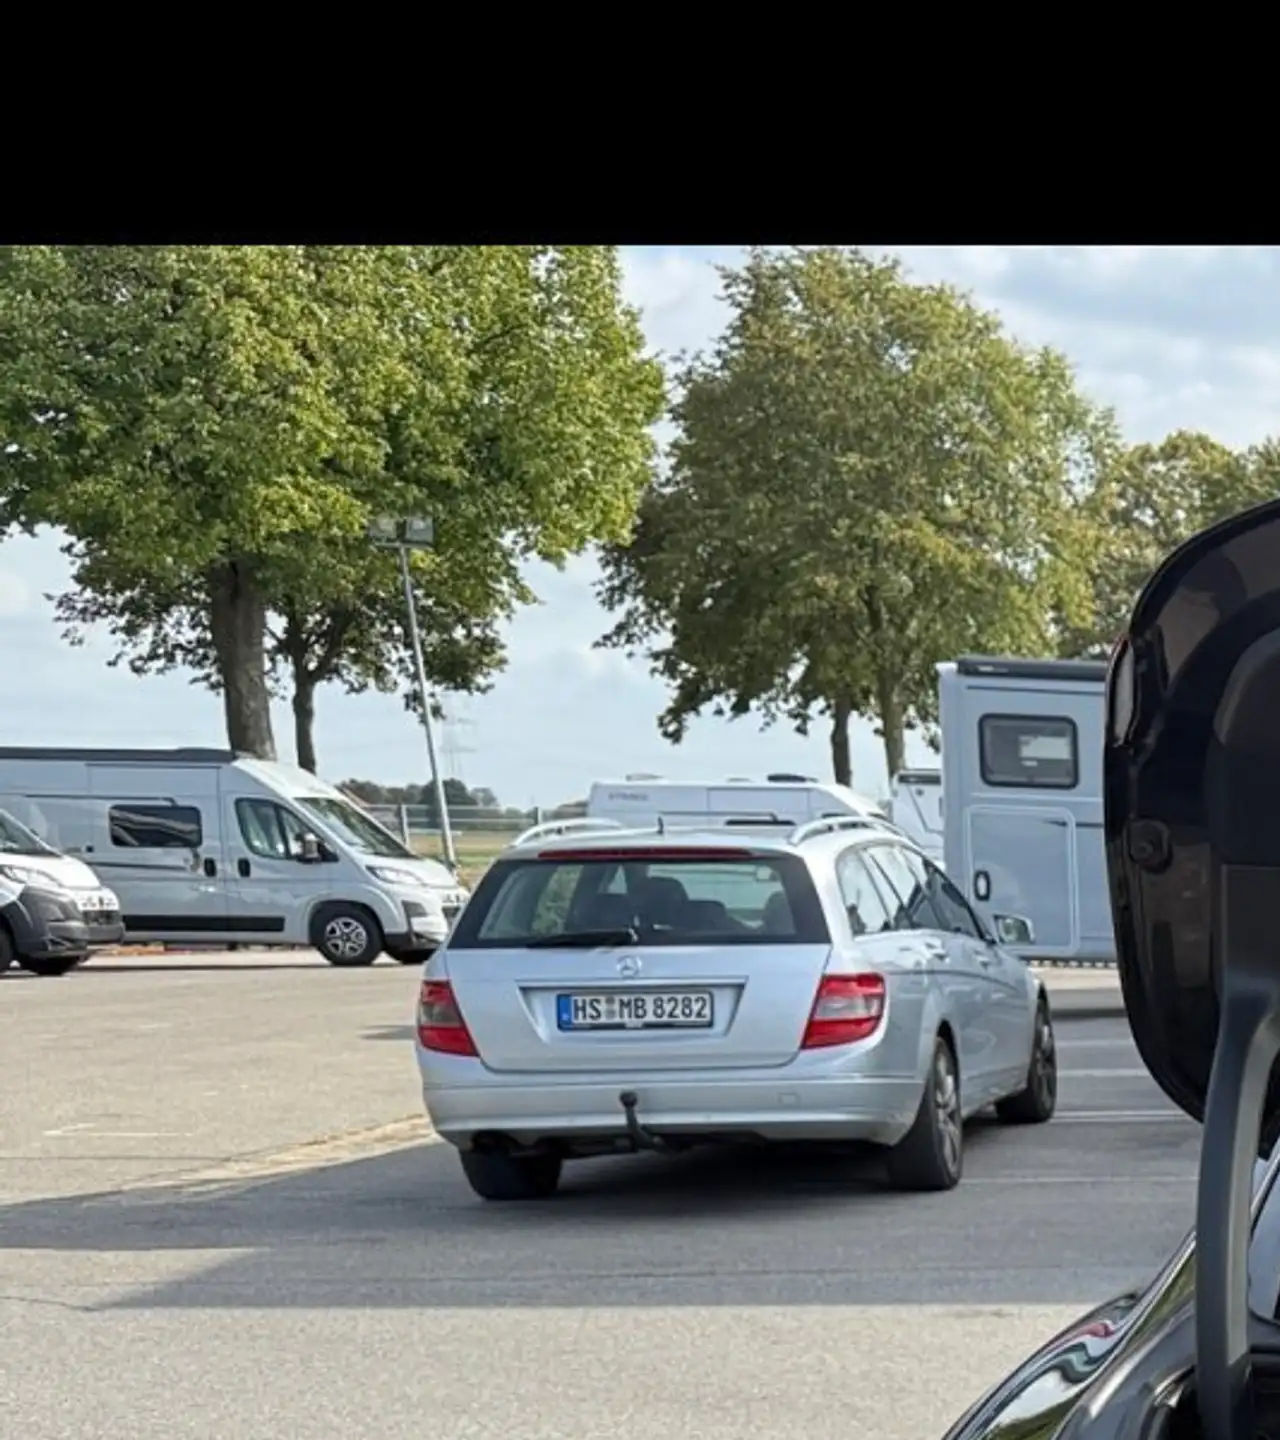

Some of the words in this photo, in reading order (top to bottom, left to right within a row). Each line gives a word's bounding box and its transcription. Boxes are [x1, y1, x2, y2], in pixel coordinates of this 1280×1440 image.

[573, 998, 602, 1020] HS
[618, 997, 647, 1019] MB
[652, 996, 707, 1019] 8282
